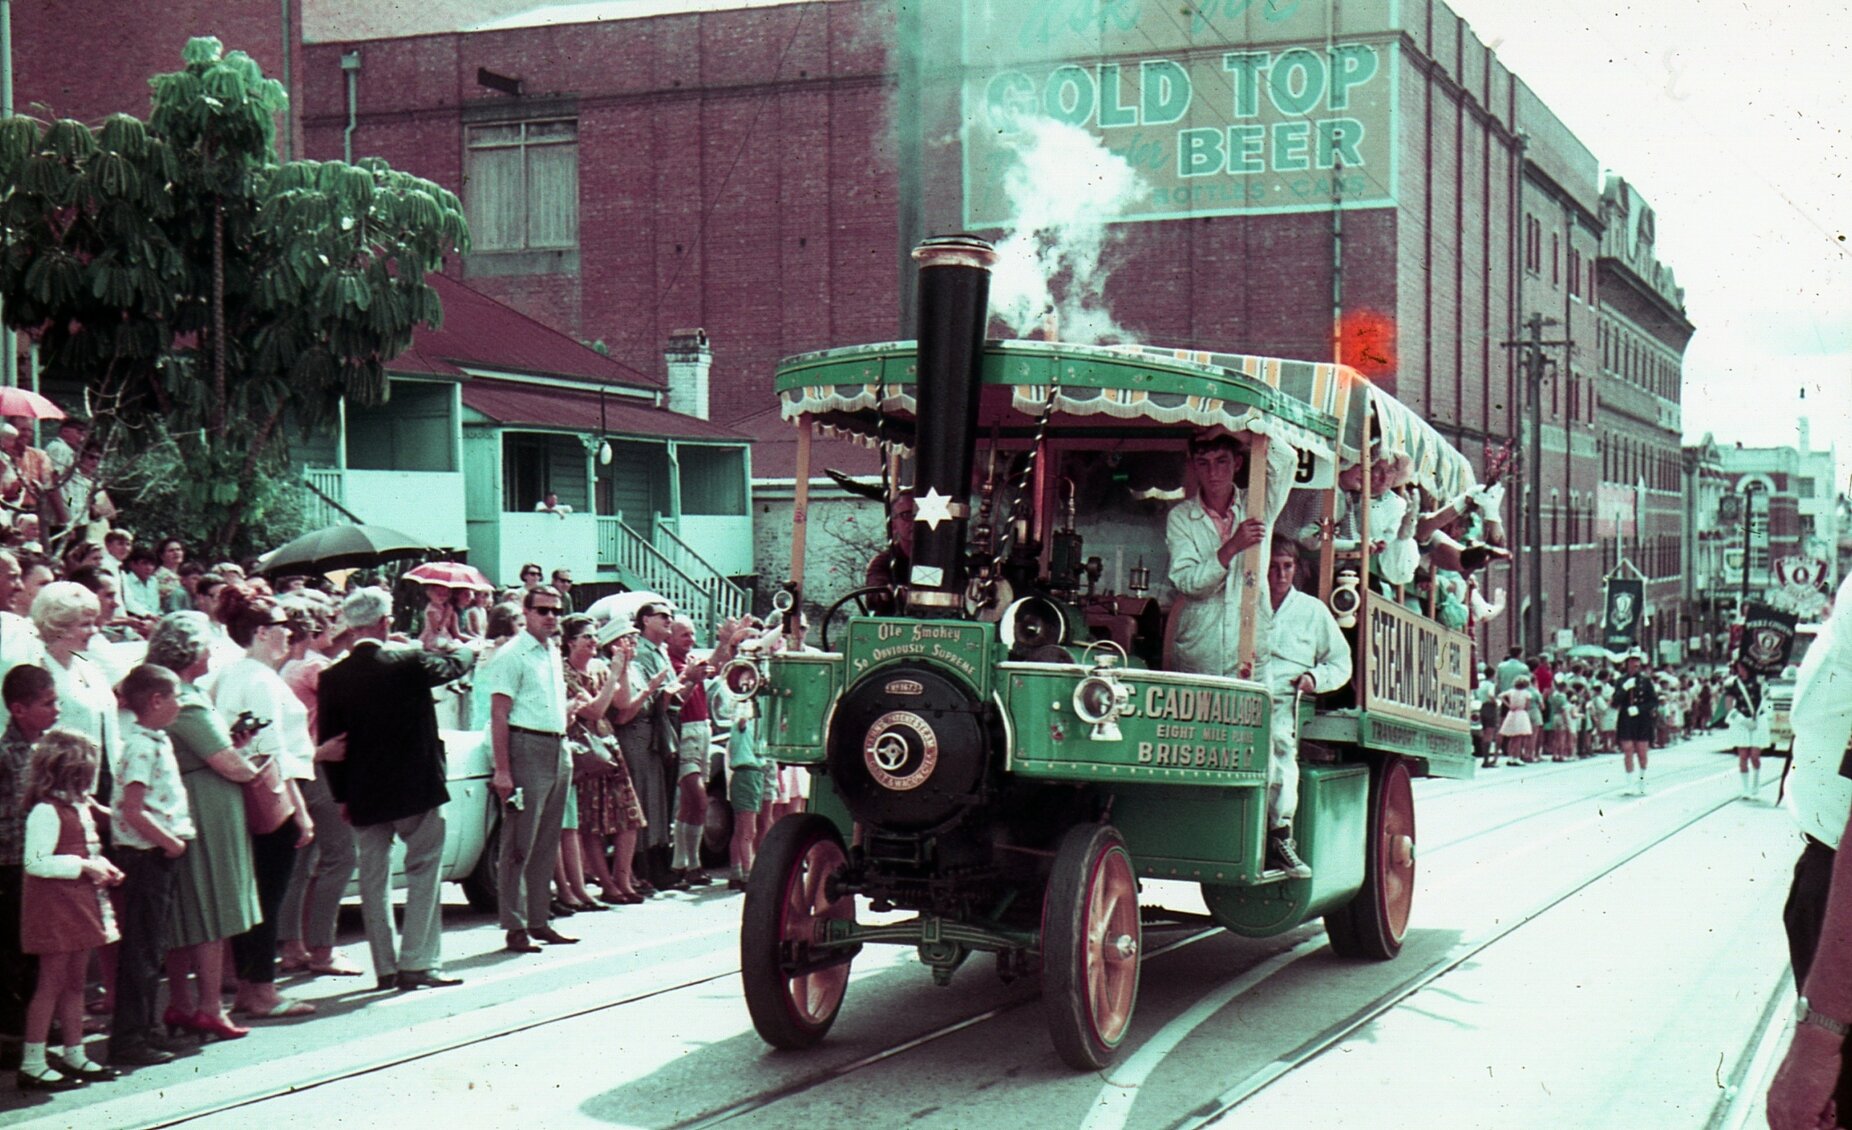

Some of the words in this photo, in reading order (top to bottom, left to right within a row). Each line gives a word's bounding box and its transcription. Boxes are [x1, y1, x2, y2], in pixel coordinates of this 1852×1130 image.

[984, 59, 1193, 131] GOLD
[1222, 43, 1379, 118] TOP
[1177, 118, 1366, 178] BEER
[878, 623, 903, 641] Ole
[911, 624, 961, 643] Smokey
[1371, 605, 1416, 707] STEAM
[1418, 627, 1441, 714] BUS
[1138, 741, 1239, 768] BRISBANE
[1156, 724, 1196, 741] EIGHT
[1202, 728, 1228, 742] MILE
